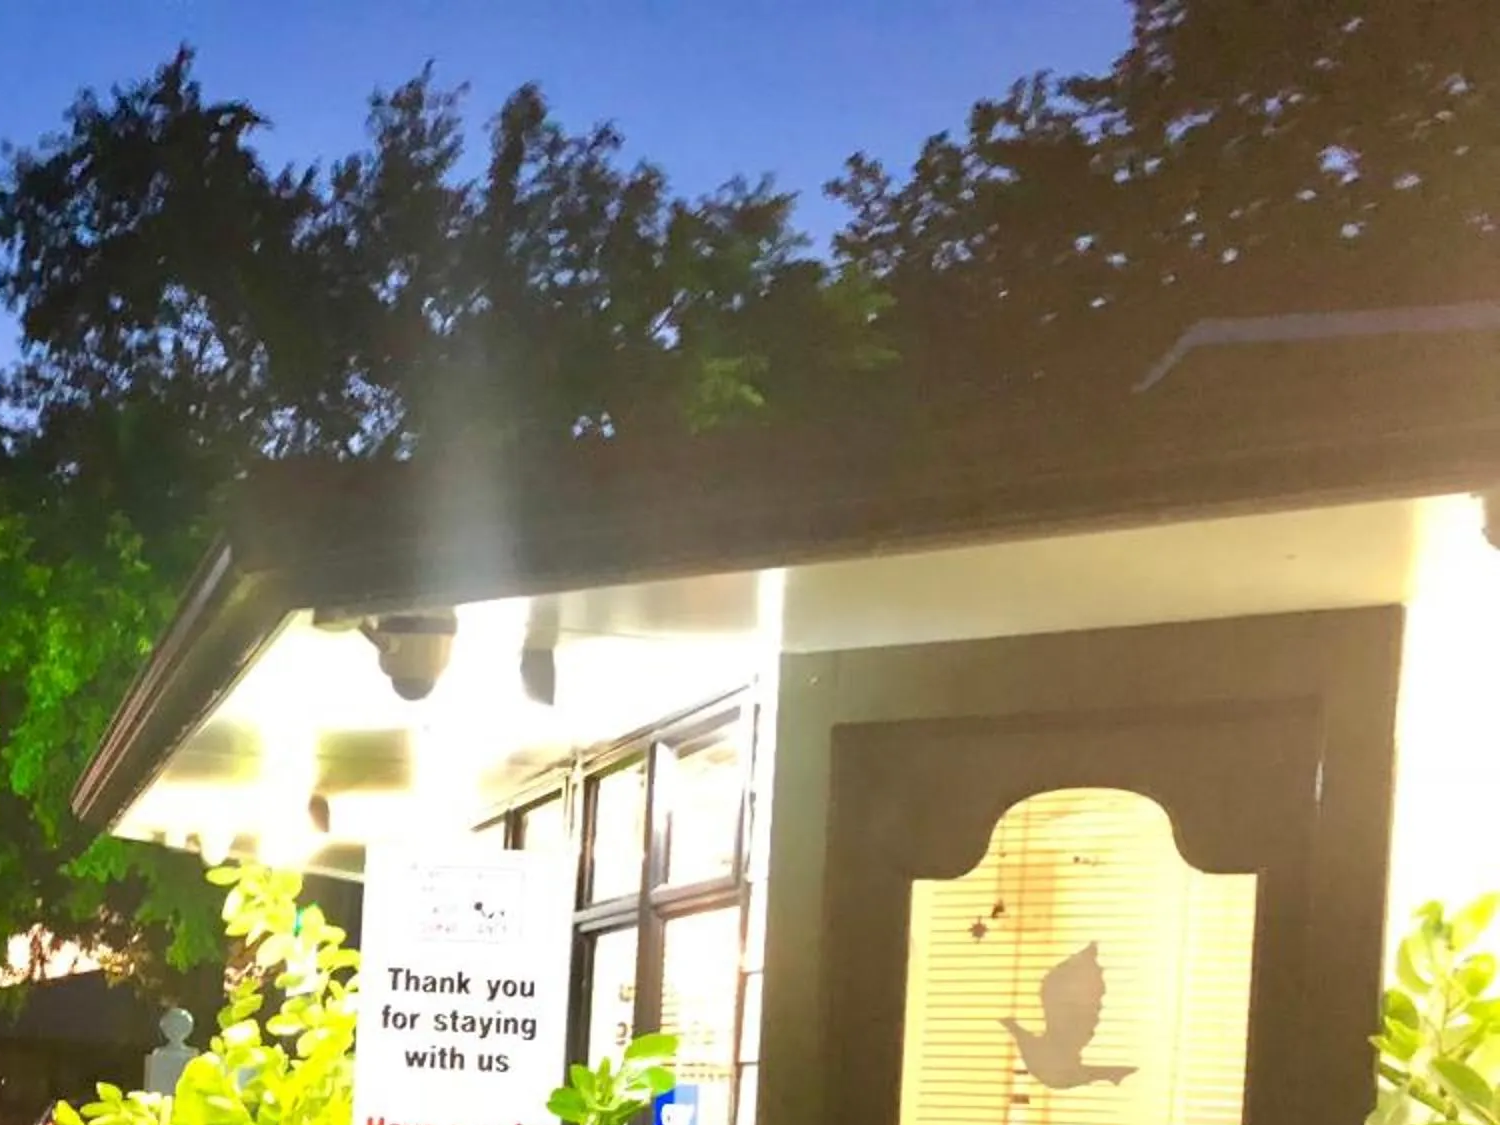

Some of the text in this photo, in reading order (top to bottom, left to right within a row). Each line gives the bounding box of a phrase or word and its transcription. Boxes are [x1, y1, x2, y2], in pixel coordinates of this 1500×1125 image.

[388, 967, 535, 1001] Thank you
[382, 1004, 537, 1040] for staying
[405, 1045, 510, 1073] with us
